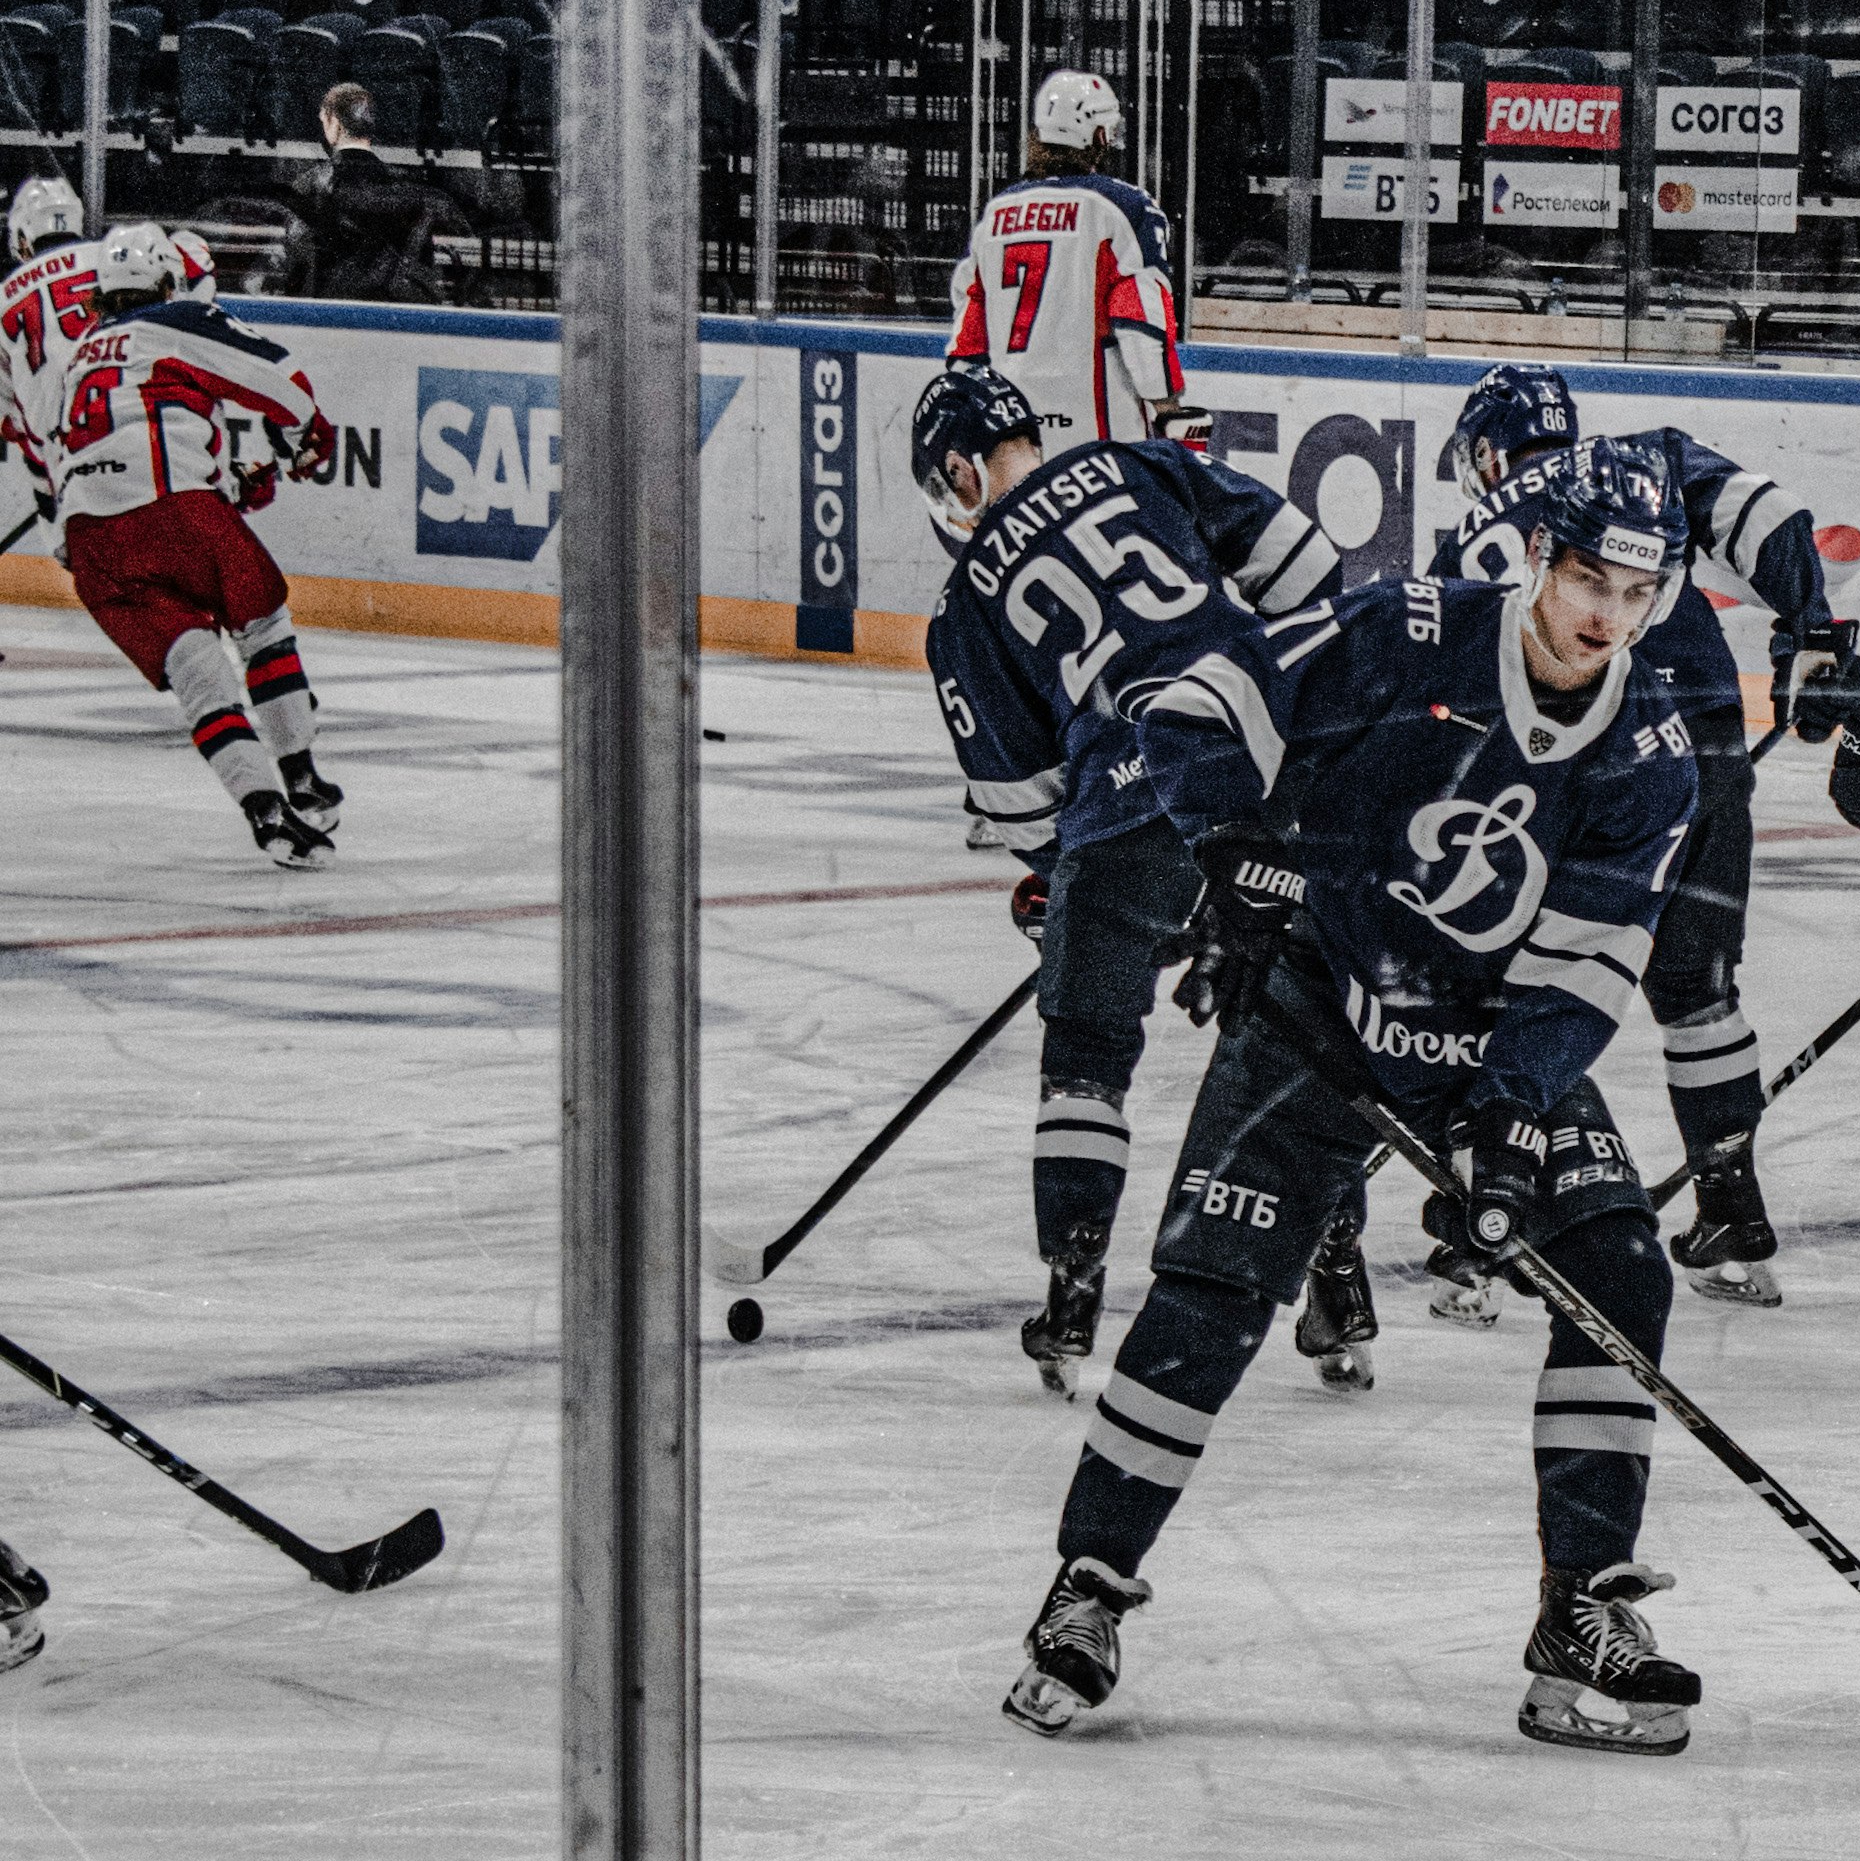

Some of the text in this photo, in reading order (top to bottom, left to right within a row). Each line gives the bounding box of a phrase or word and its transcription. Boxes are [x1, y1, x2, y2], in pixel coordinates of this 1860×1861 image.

[1489, 95, 1620, 136] FONBET
[1670, 102, 1785, 136] согаз
[1511, 192, 1613, 216] Ростелеком
[1702, 187, 1794, 209] mastercard
[991, 201, 1080, 237] TELEGIN
[1001, 240, 1053, 354] 7
[811, 357, 846, 589] согаз
[1605, 536, 1660, 562] согаз
[1004, 494, 1210, 708] 25
[1201, 1183, 1280, 1231] ВТБ
